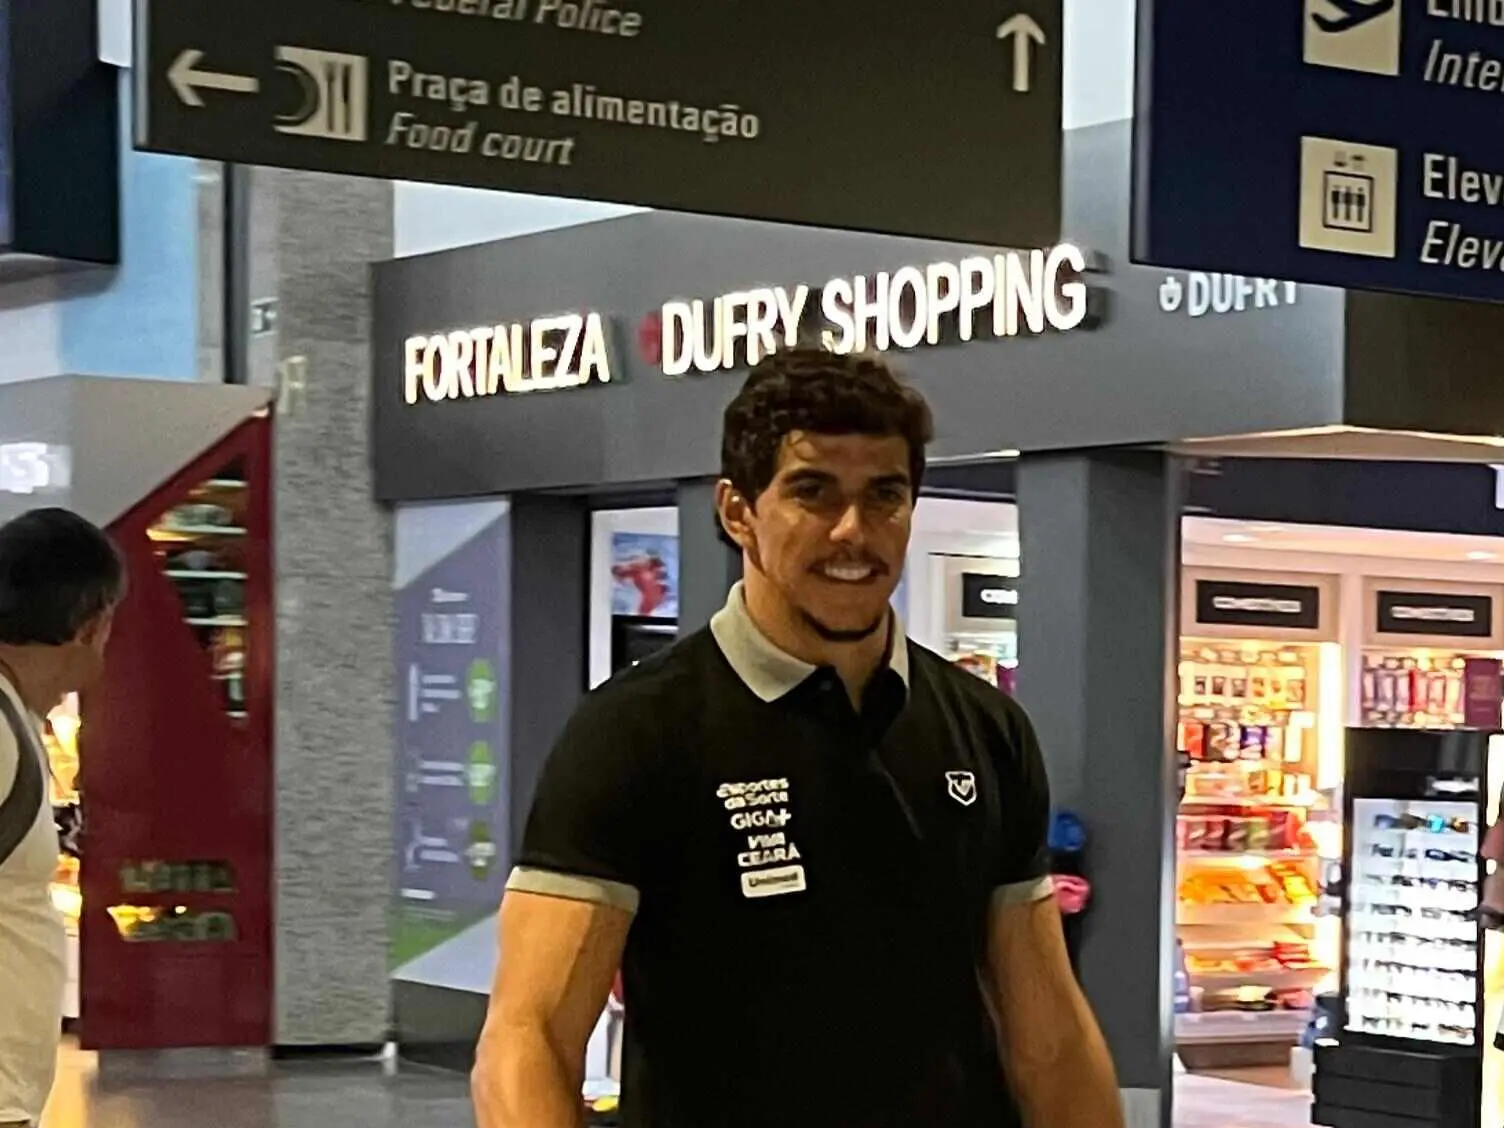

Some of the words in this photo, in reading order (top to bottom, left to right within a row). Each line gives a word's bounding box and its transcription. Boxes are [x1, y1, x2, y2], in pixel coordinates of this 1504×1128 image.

[393, 0, 527, 20] eral
[534, 0, 643, 36] Police
[387, 59, 489, 112] Praça
[500, 75, 543, 112] de
[552, 83, 760, 142] alimentação
[384, 112, 479, 154] Food
[481, 132, 575, 165] court
[404, 311, 611, 405] FORTALEZA
[661, 284, 809, 376] DUFRY
[821, 243, 1087, 355] SHOPPING
